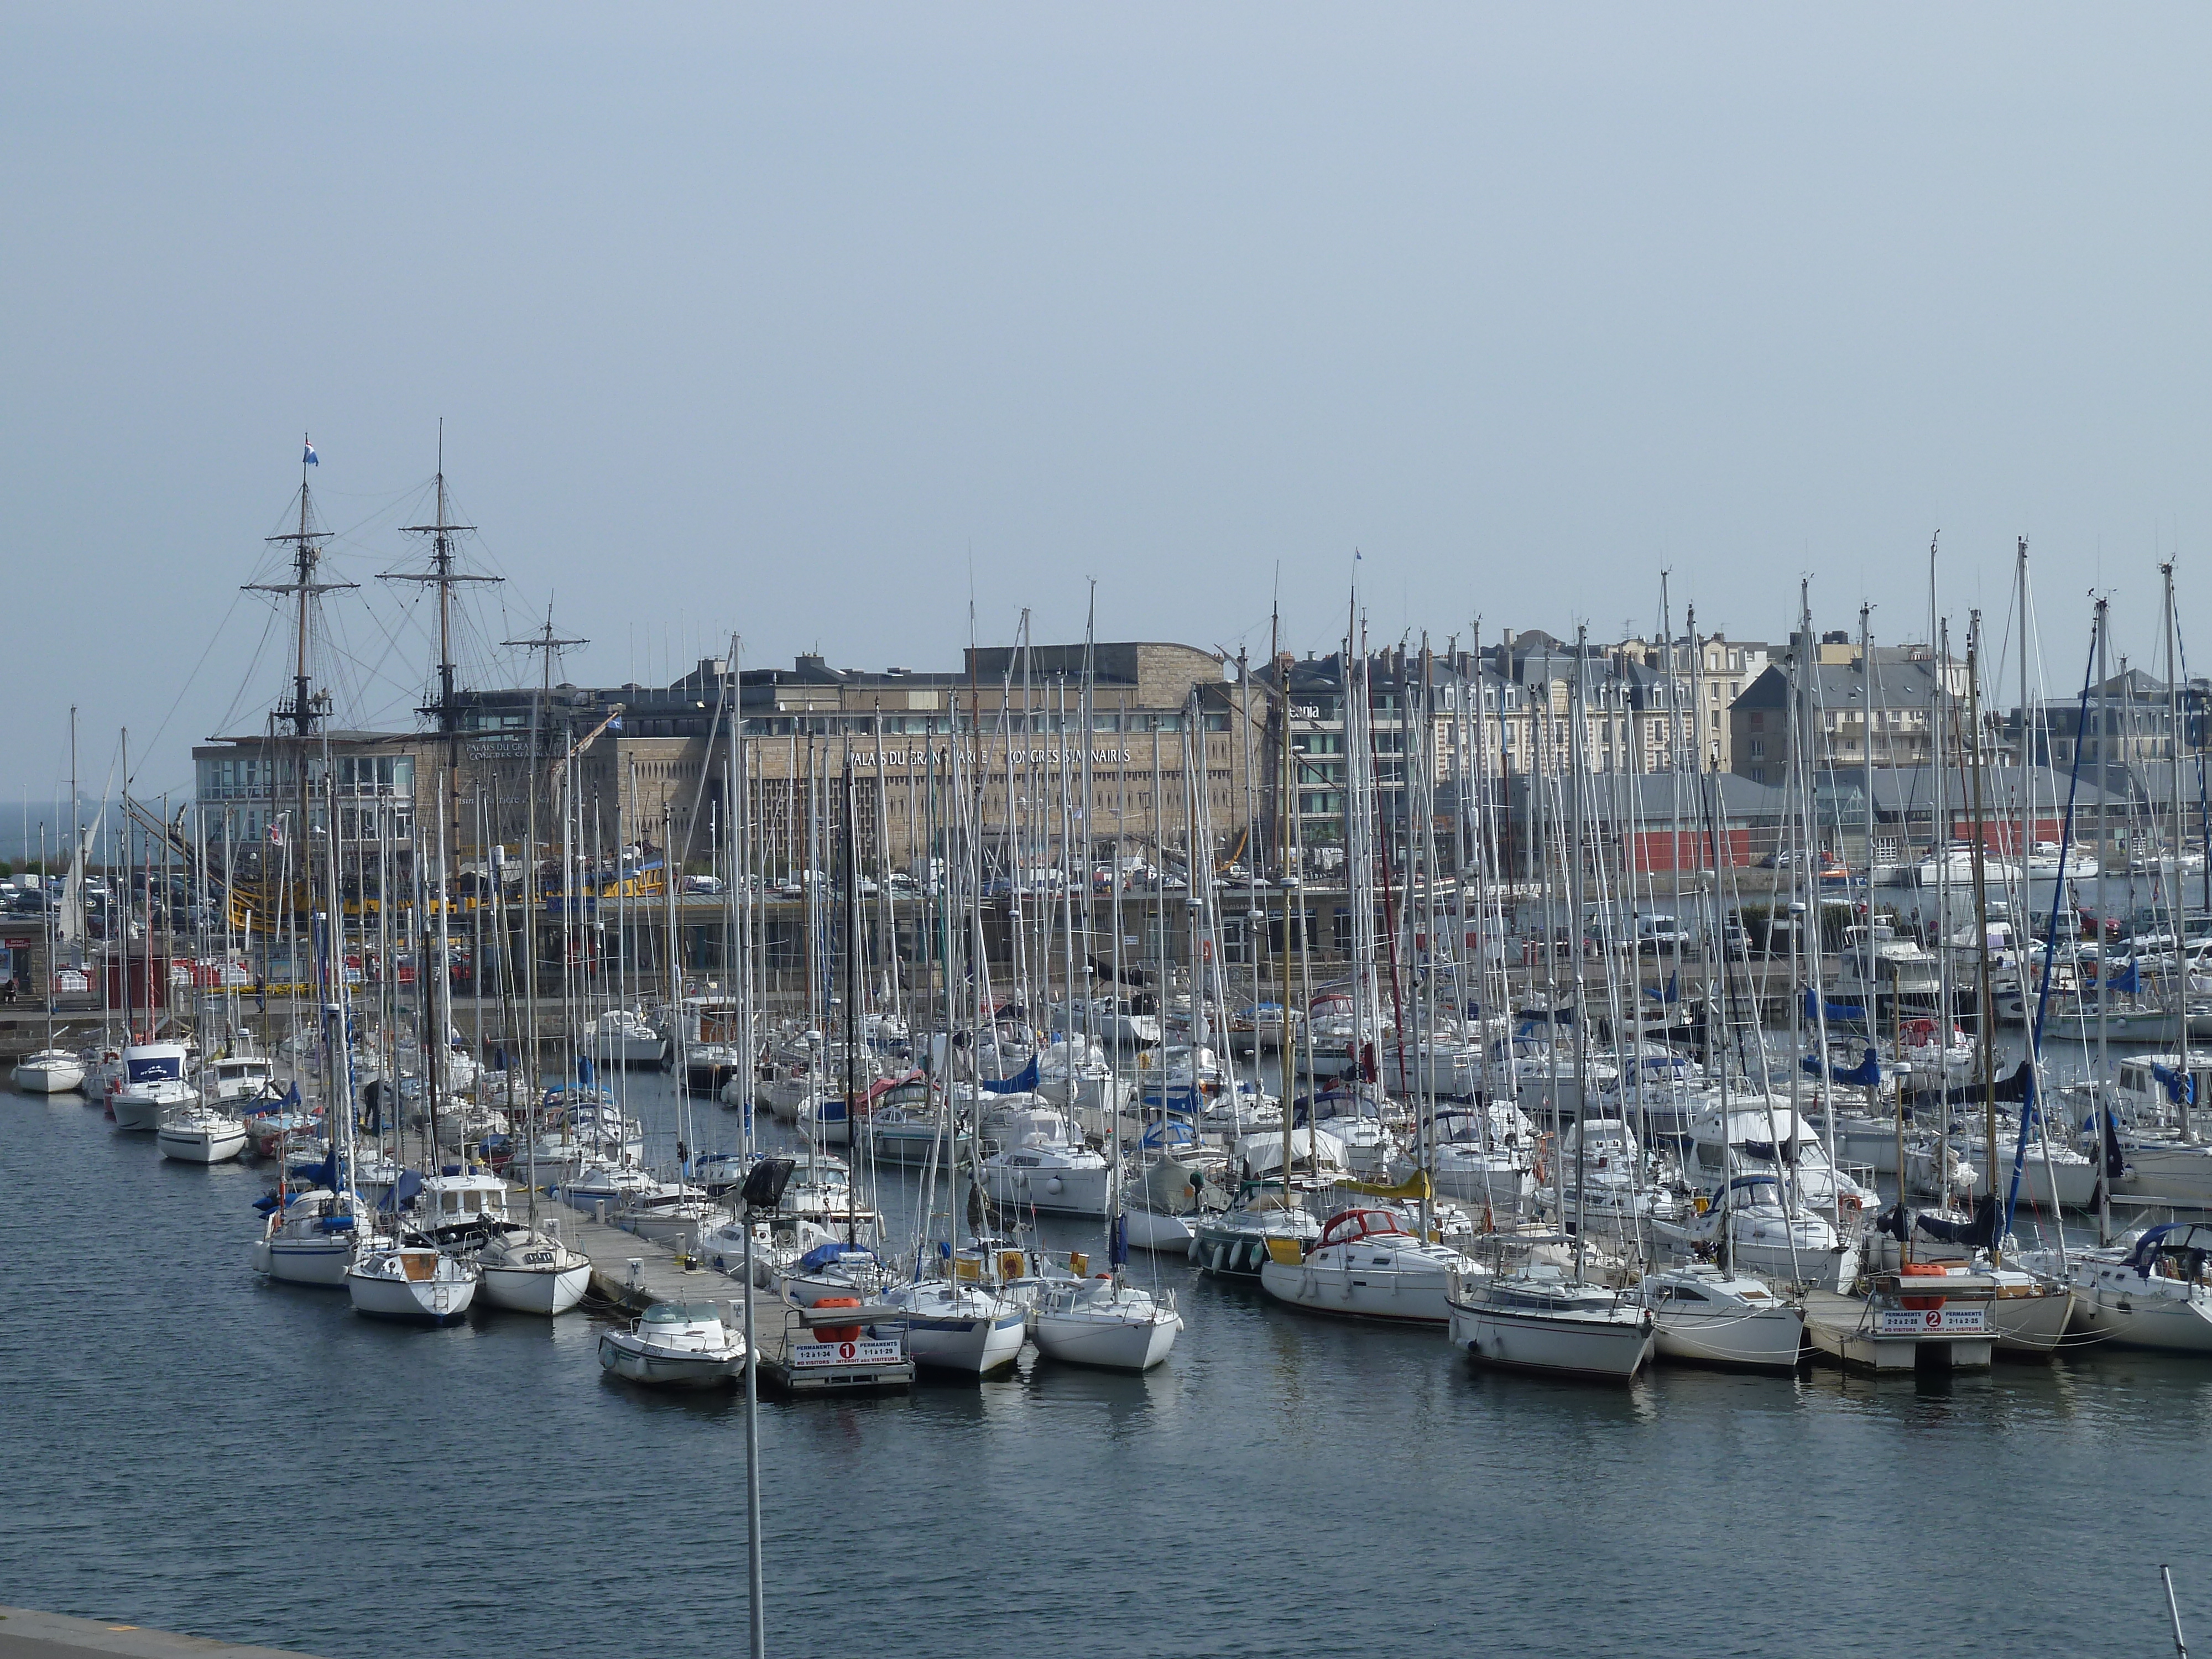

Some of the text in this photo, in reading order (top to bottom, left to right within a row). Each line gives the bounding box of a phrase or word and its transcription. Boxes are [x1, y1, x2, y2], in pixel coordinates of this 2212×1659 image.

[889, 751, 905, 765] DU
[1928, 1312, 1938, 1326] 2
[842, 1344, 850, 1358] 1
